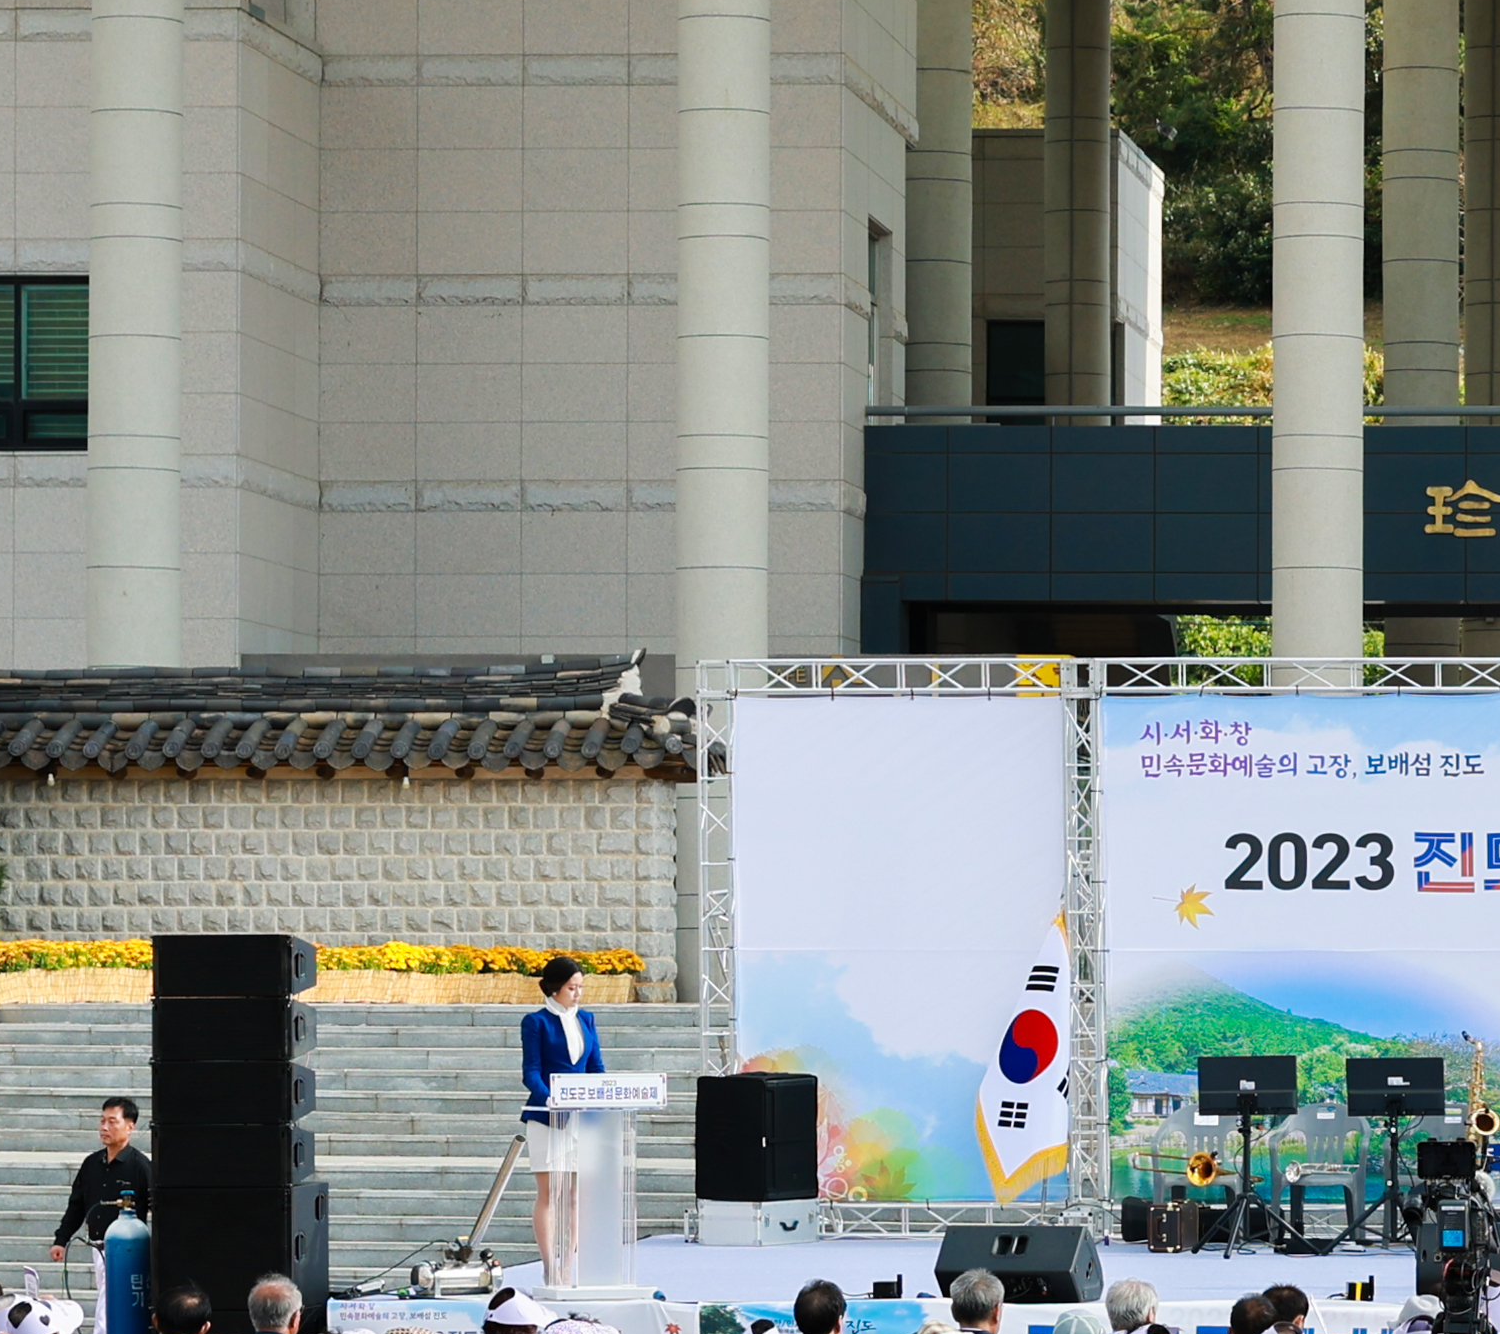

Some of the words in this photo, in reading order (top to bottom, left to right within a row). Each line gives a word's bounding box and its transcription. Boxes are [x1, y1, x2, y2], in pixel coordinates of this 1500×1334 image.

[1140, 752, 1299, 779] 민속문화예술의
[1305, 754, 1358, 780] 고장,
[1364, 751, 1432, 778] 보배섬
[1439, 752, 1485, 778] 진도
[1223, 831, 1396, 892] 2023
[560, 1087, 586, 1101] 진도군
[614, 1086, 659, 1100] 문화예술제
[339, 1311, 390, 1321] 민속문화예술의
[409, 1311, 430, 1321] 보배섬
[432, 1311, 448, 1321] 진도
[844, 1317, 877, 1334] 진도
